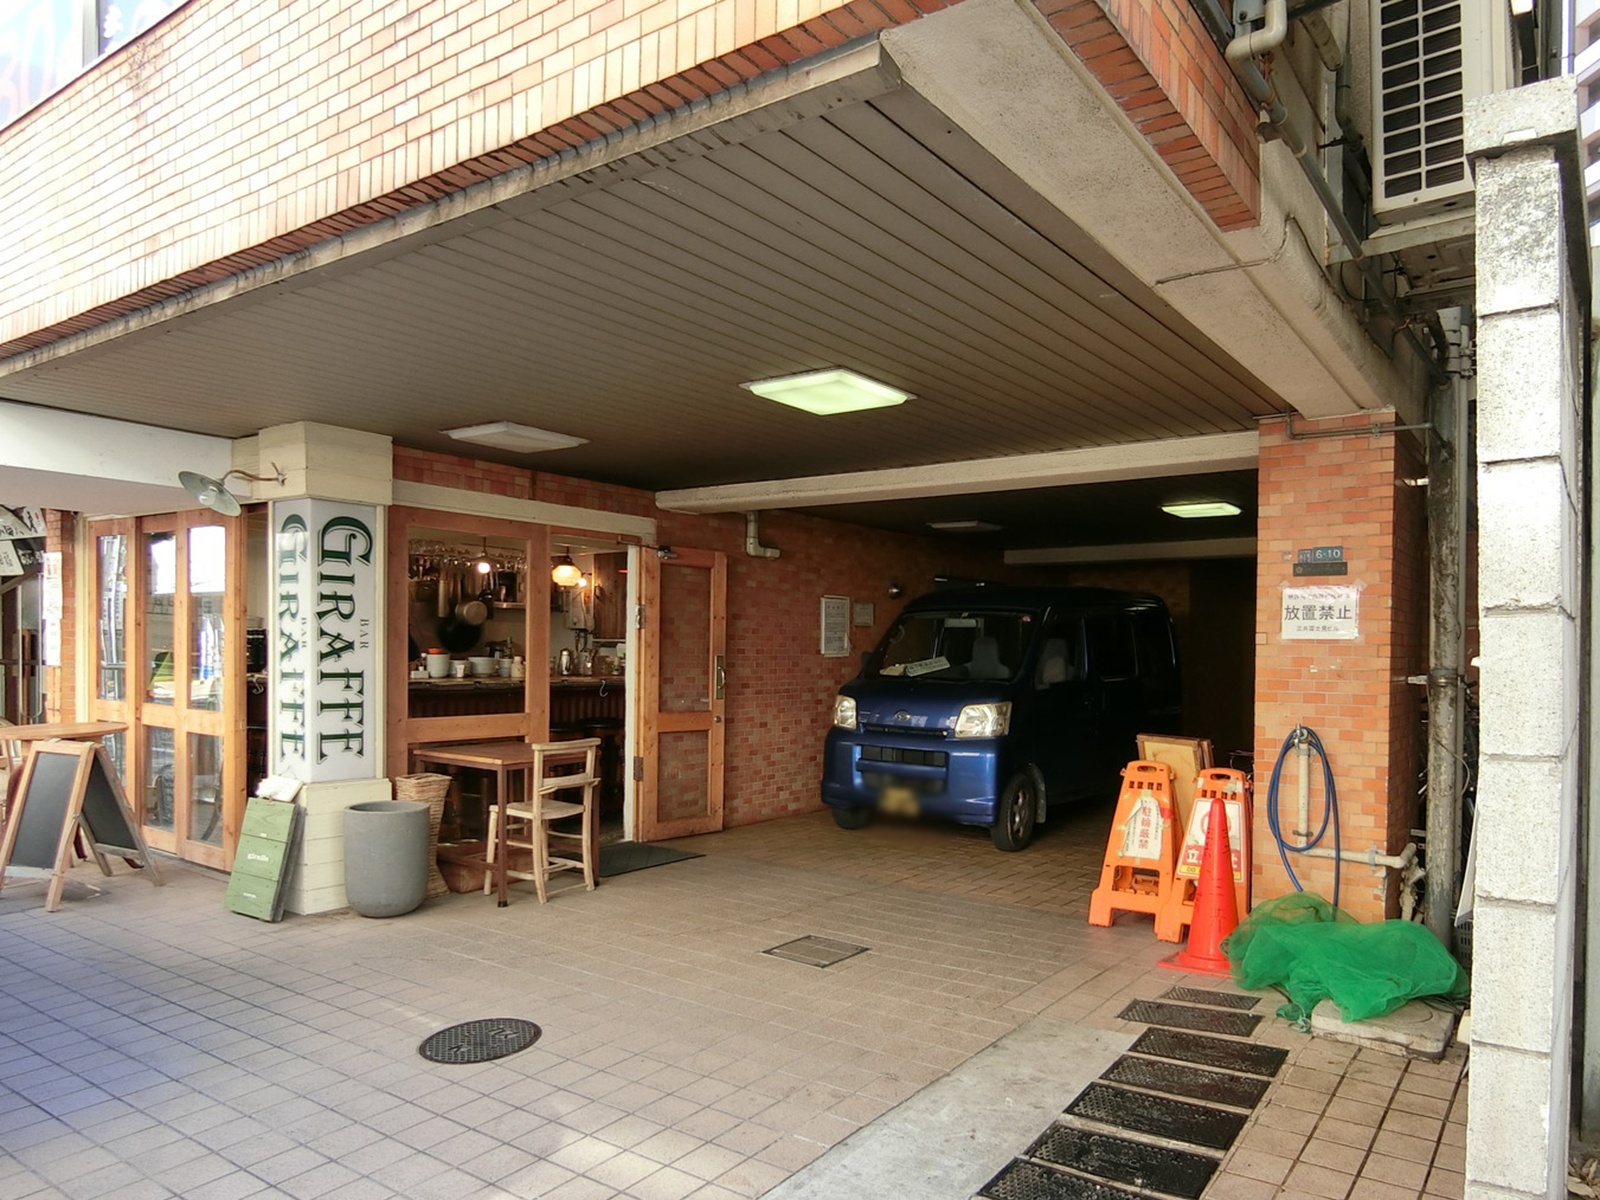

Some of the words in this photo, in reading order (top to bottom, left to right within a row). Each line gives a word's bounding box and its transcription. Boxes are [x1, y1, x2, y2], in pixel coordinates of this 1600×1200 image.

[279, 513, 308, 762] GIRAFFE
[315, 515, 373, 765] GIRAFFE
[360, 618, 370, 650] BAR
[1284, 604, 1353, 621] 放置禁止
